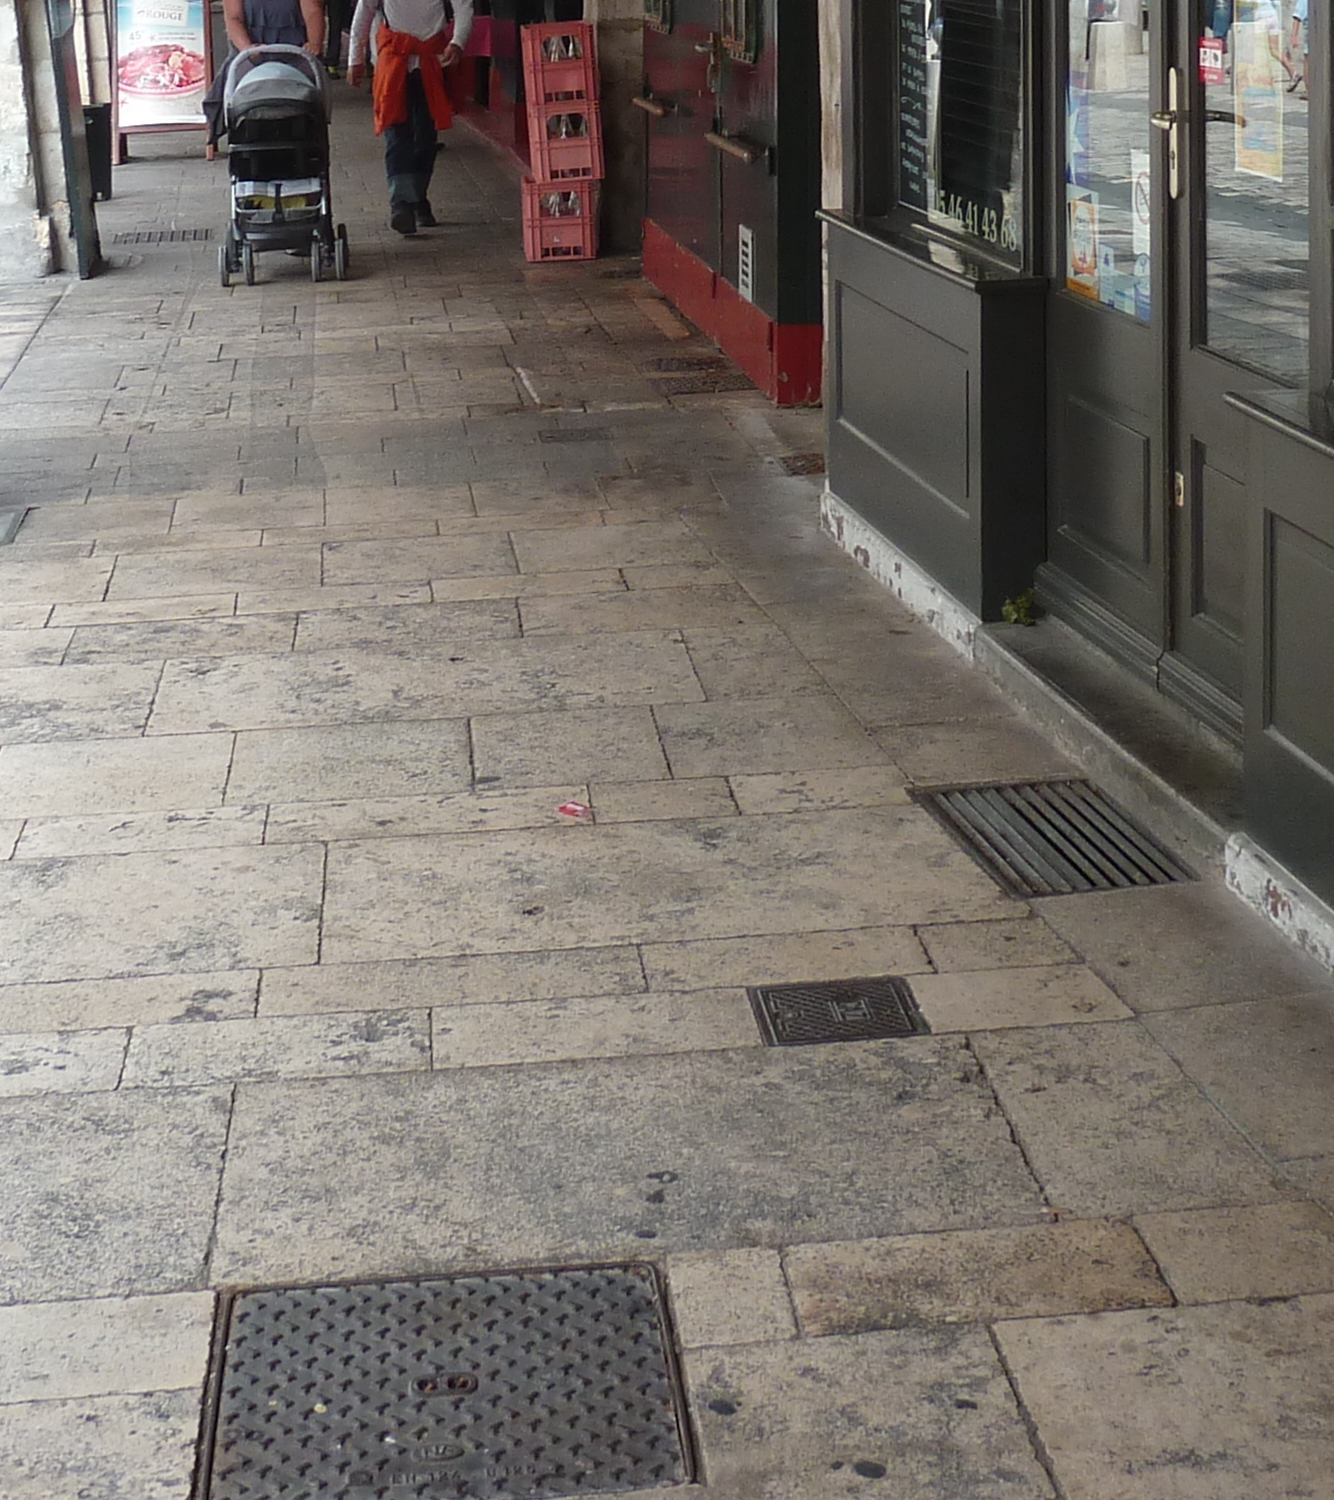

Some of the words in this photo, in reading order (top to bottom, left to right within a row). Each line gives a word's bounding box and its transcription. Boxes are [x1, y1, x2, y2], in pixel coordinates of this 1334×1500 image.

[966, 200, 980, 235] 41
[981, 207, 997, 243] 43
[1000, 215, 1018, 252] 68
